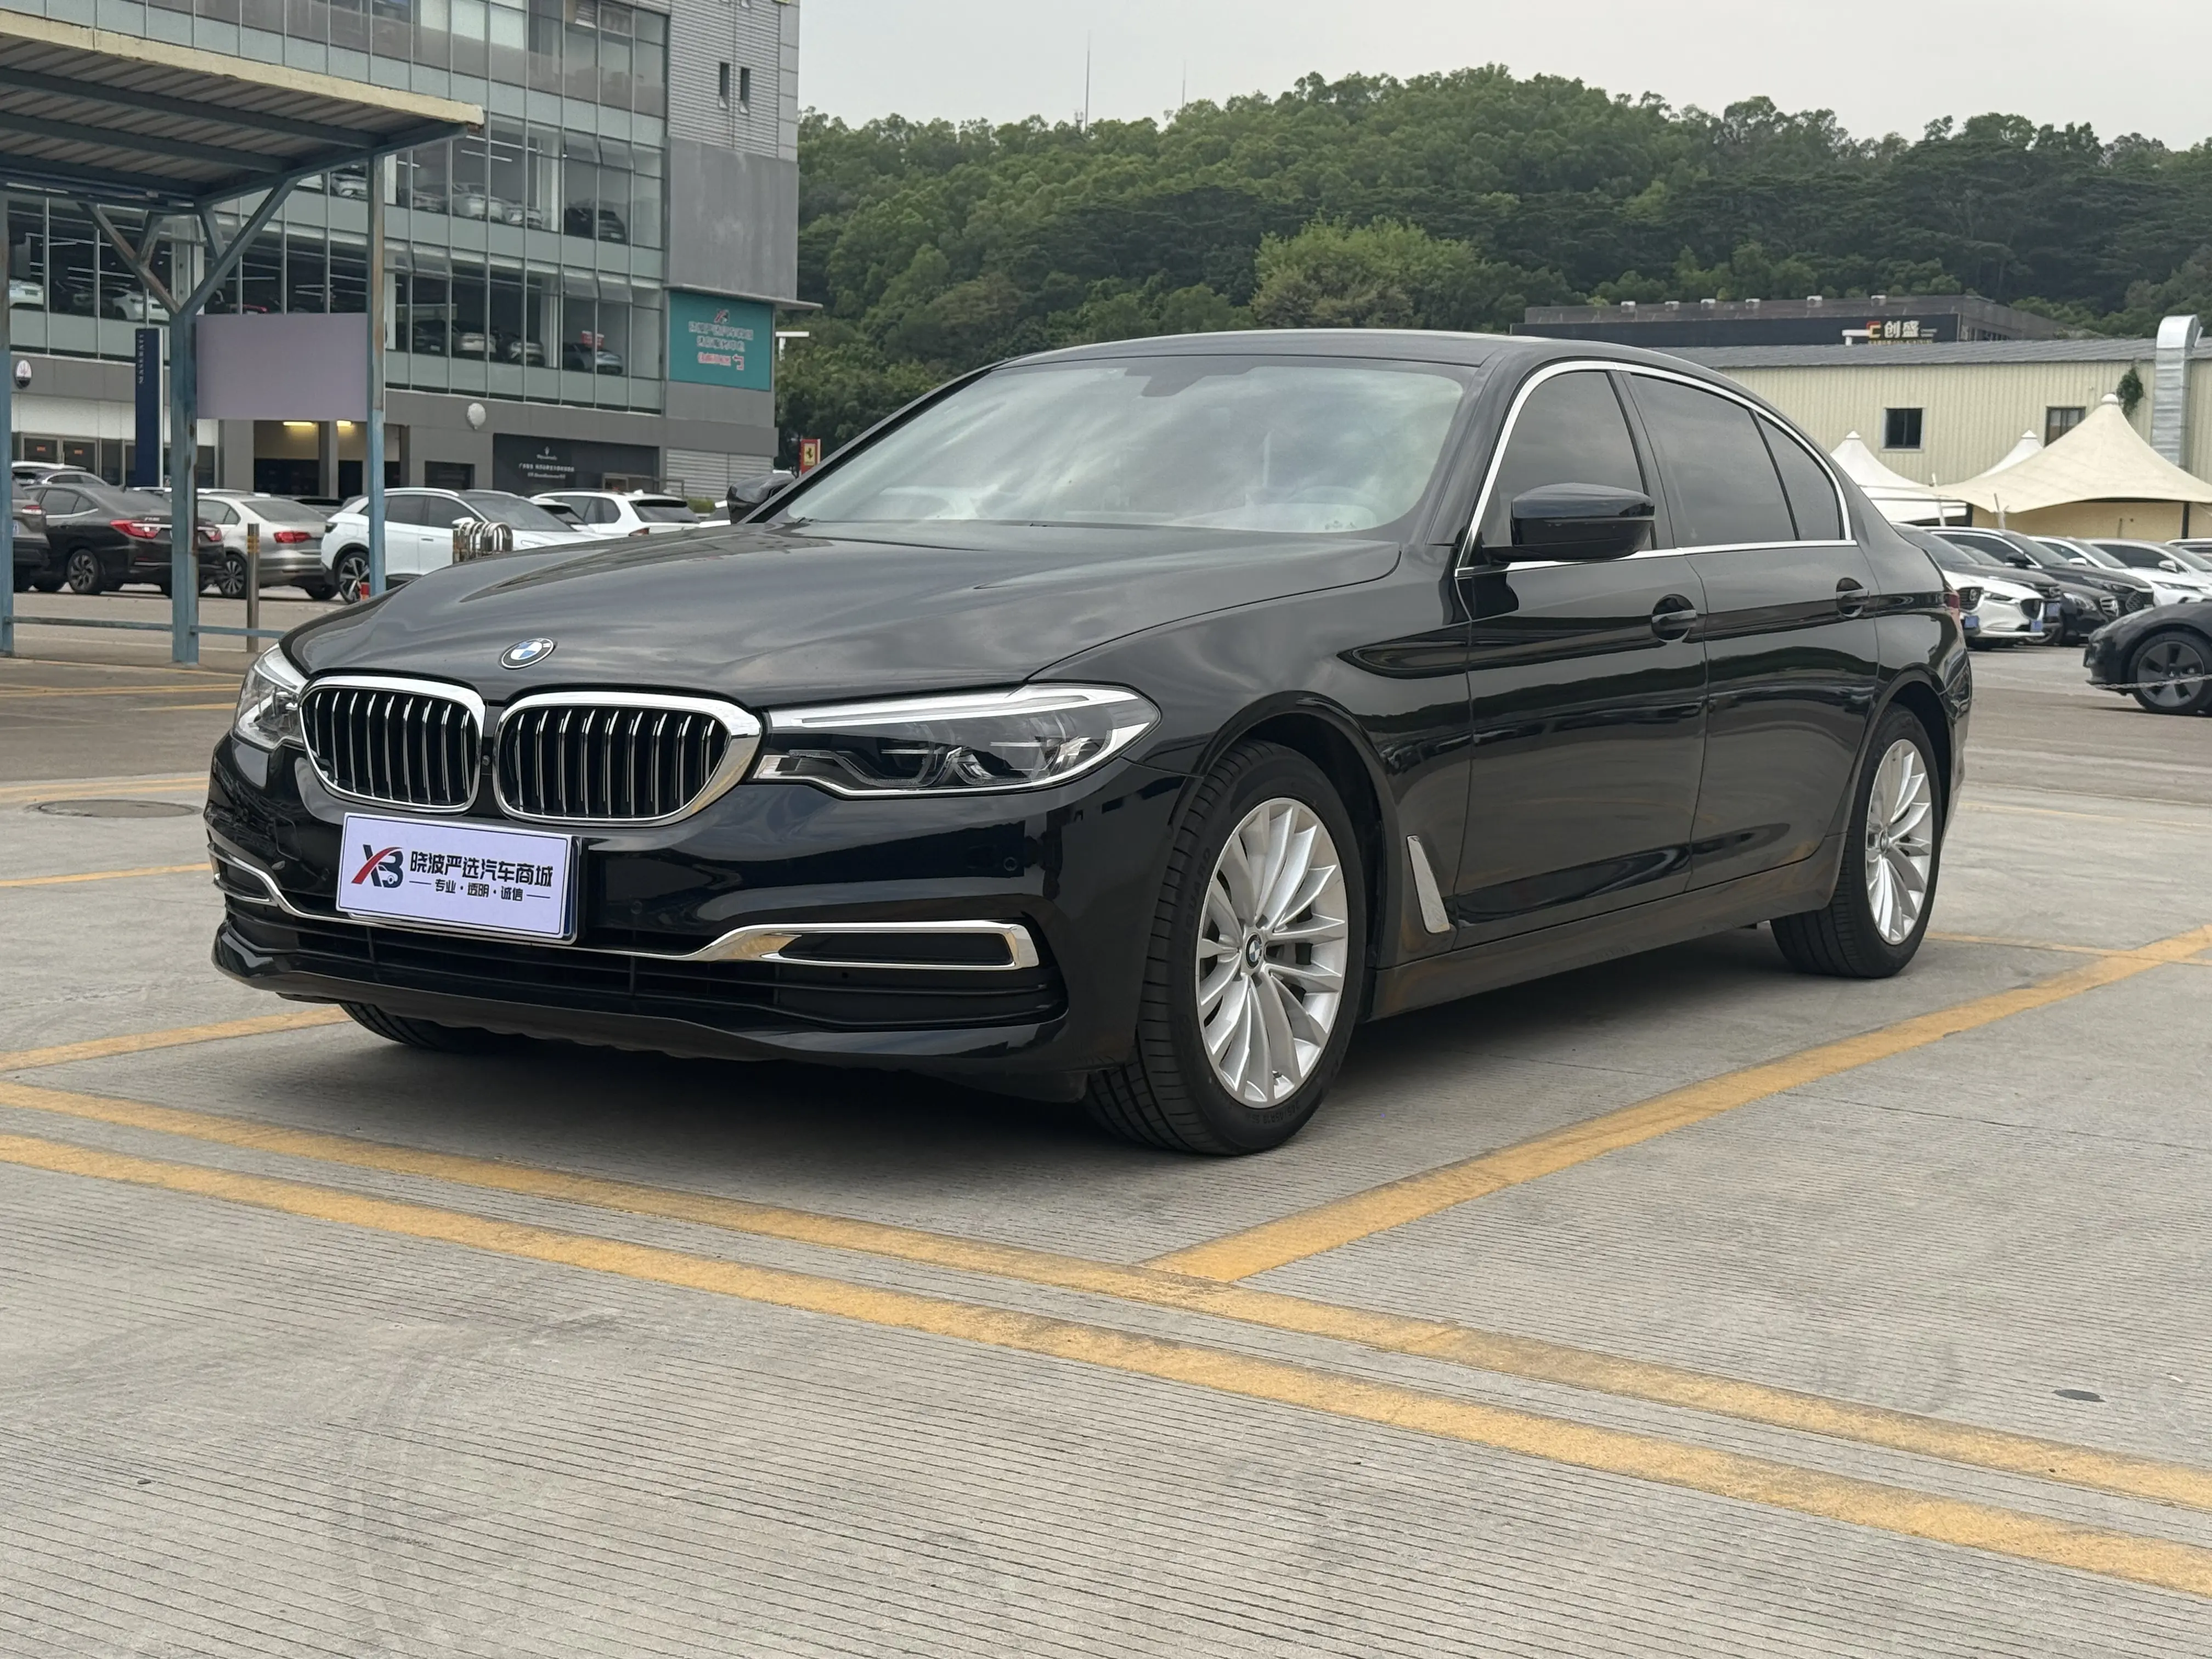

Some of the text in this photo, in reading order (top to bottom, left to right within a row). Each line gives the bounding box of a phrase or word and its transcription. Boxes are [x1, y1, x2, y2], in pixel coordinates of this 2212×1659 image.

[1884, 320, 1920, 338] 创盛
[410, 850, 553, 887] 晓波严选汽车商城
